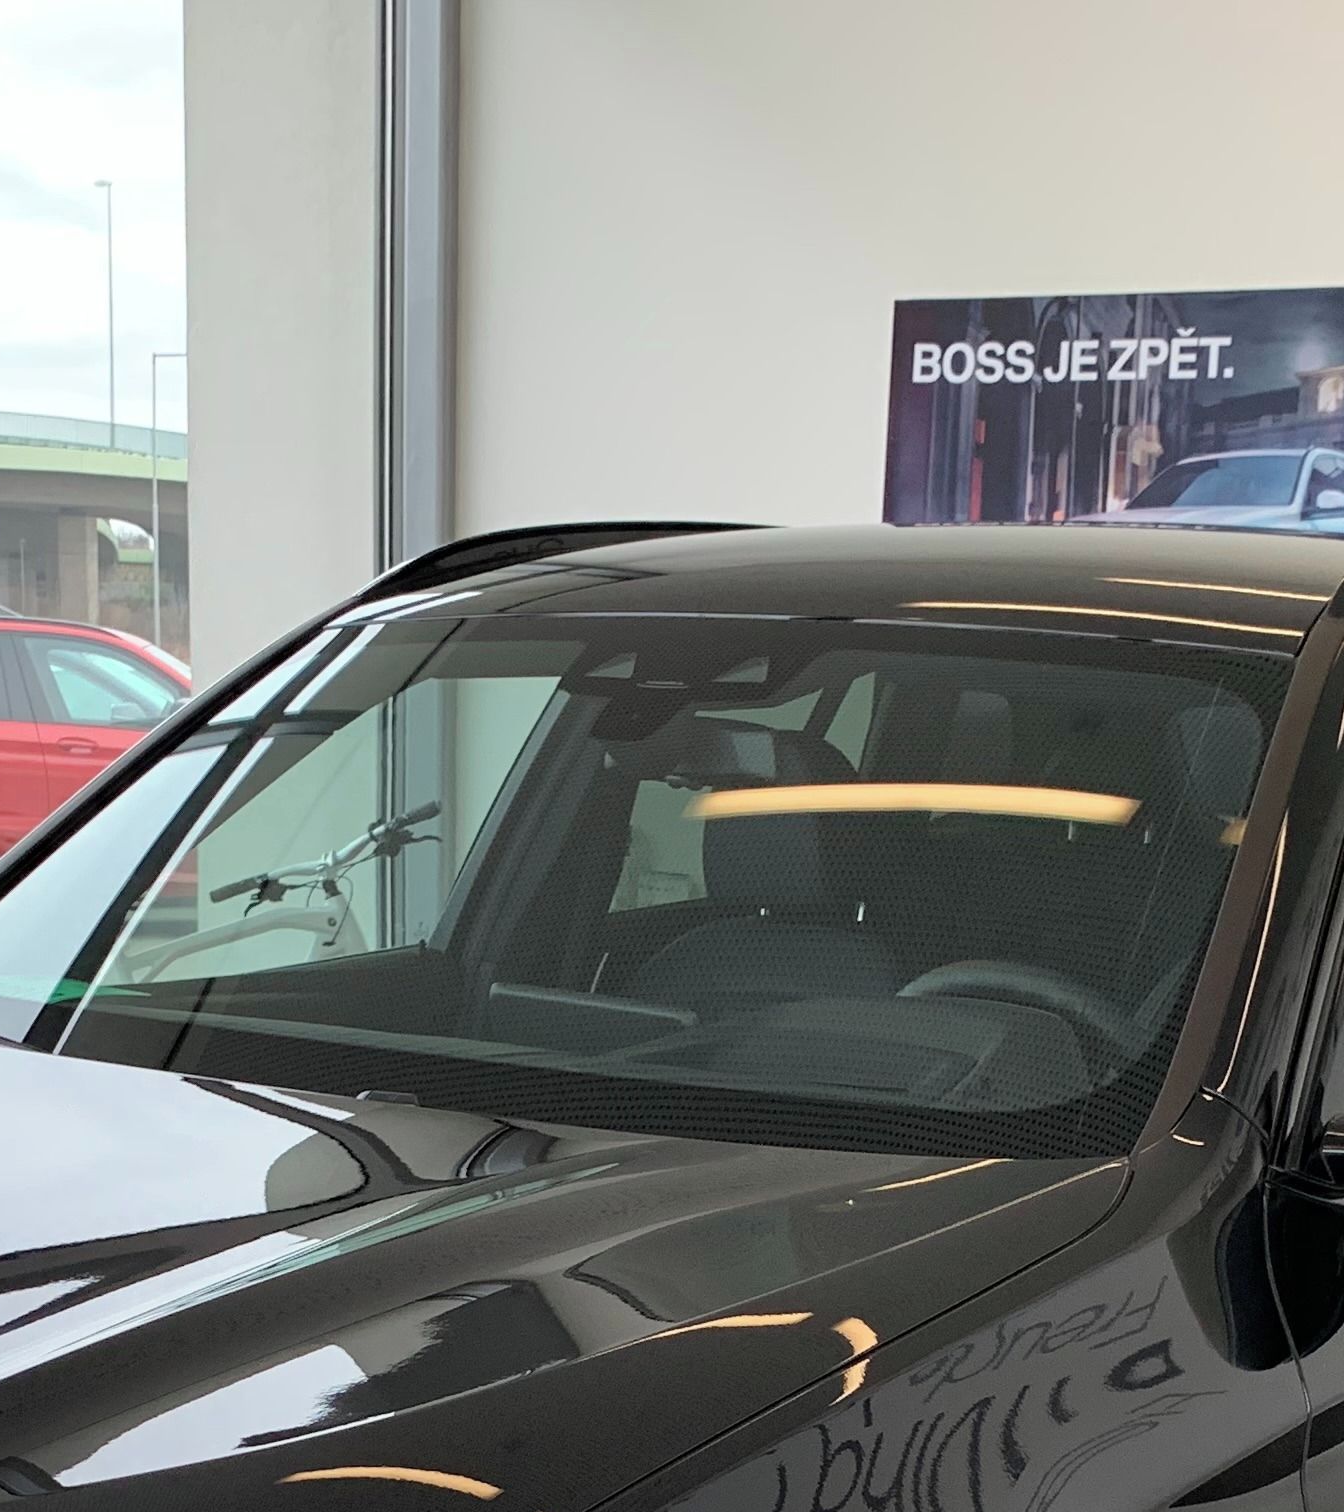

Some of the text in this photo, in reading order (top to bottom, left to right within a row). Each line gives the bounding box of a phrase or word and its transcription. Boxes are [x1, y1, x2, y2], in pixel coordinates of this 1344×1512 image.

[912, 327, 1234, 384] BOSS JE ZPĚT.
